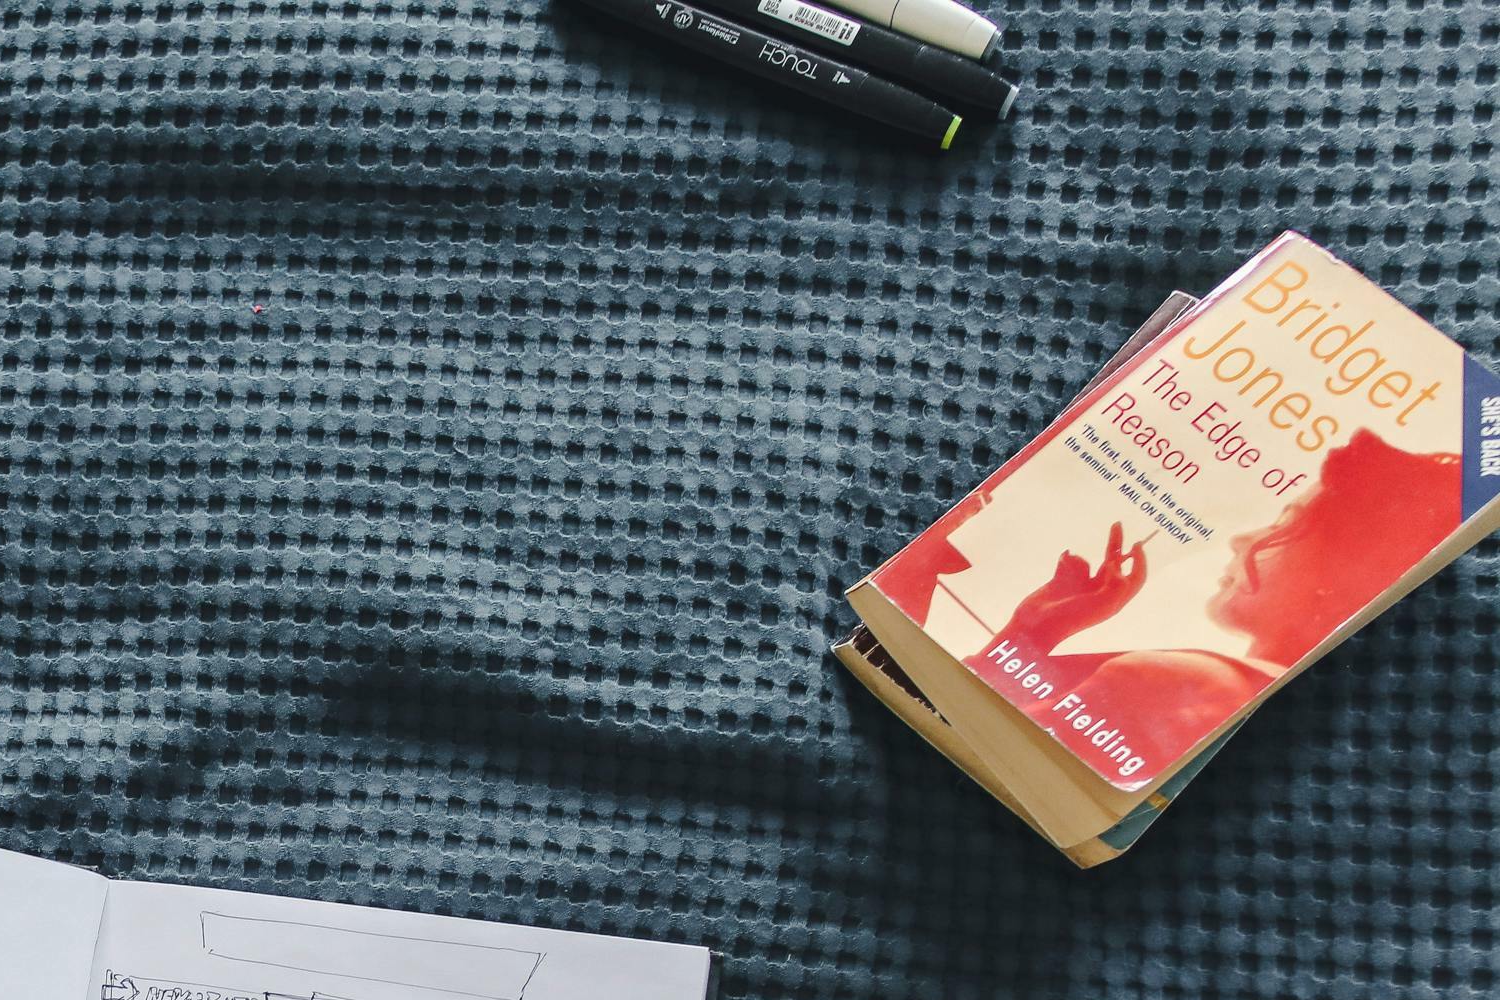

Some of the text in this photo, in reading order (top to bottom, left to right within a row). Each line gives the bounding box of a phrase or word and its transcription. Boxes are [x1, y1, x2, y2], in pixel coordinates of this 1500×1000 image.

[759, 43, 818, 79] TOUCH
[1183, 321, 1339, 452] Jones
[1242, 260, 1441, 426] Bridget
[1101, 392, 1200, 484] Reason
[1142, 359, 1307, 497] The Edge of
[1065, 437, 1081, 452] the
[1118, 484, 1140, 504] MAIL
[1140, 501, 1157, 516] ON
[1154, 513, 1193, 544] SUNDAY
[1099, 441, 1120, 463] first,
[1120, 460, 1136, 476] the
[1136, 473, 1159, 496] best,
[1159, 493, 1176, 509] the
[1176, 507, 1215, 541] original,
[988, 640, 1145, 776] Helen Fielding
